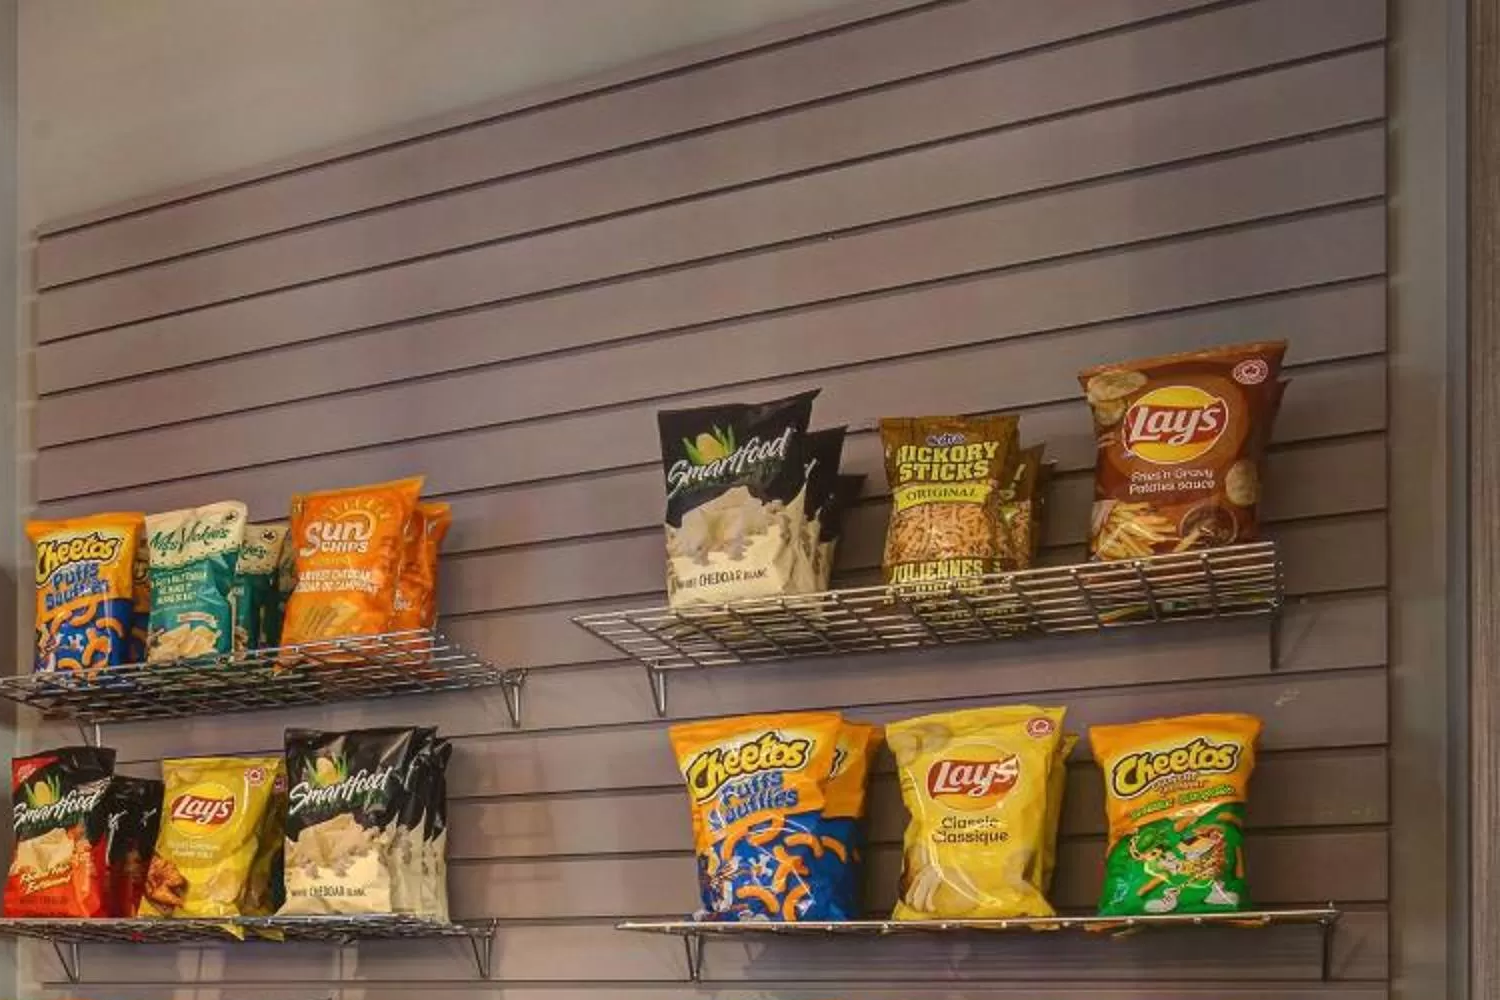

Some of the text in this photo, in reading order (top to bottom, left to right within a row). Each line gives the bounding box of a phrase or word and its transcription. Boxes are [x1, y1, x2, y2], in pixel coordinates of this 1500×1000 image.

[1129, 404, 1221, 446] Lay's
[667, 427, 793, 499] Smartfood
[896, 441, 1000, 465] HICKORY
[899, 460, 990, 481] STICKS
[906, 487, 978, 501] ORIGINAL
[299, 519, 377, 556] Sun
[35, 531, 120, 585] Cheetos
[891, 559, 983, 584] JULIENNES
[686, 732, 810, 800] Cheetos
[933, 757, 1019, 797] Lay's
[1113, 738, 1240, 797] Cheetos
[288, 767, 393, 815] Smartfood
[932, 830, 1010, 845] Classique
